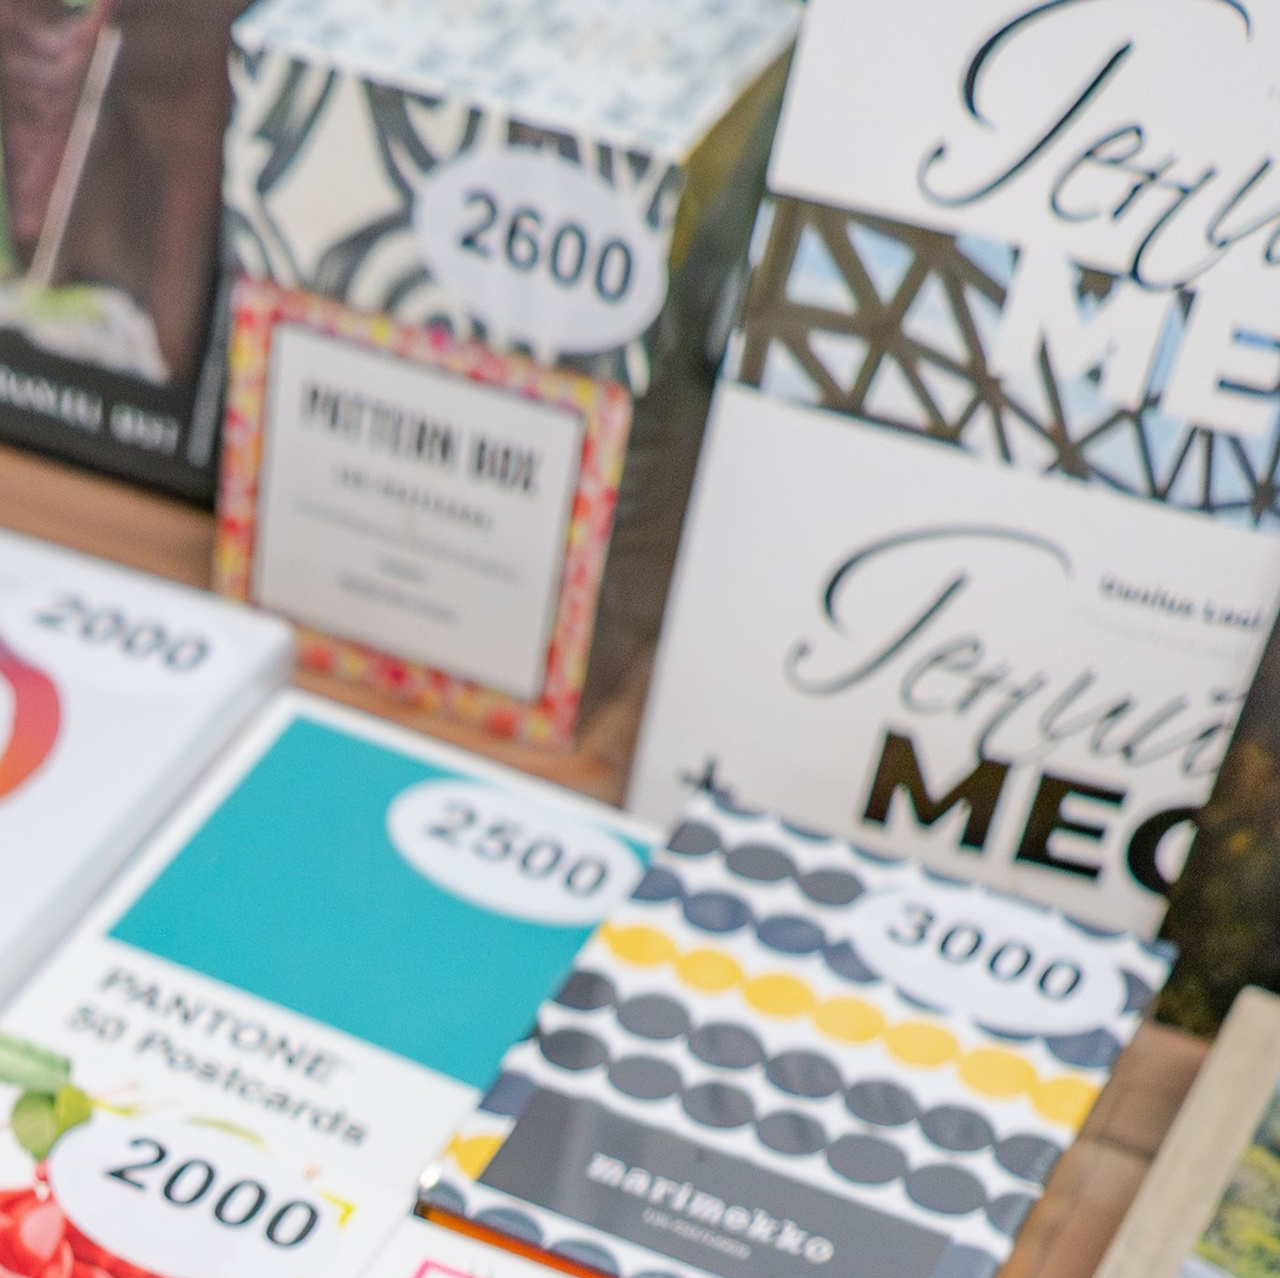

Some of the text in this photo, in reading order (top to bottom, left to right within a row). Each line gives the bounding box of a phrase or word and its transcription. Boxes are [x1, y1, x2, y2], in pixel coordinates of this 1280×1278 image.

[457, 188, 634, 304] 2600
[35, 591, 211, 674] 2000
[426, 799, 608, 899] 2500
[889, 902, 1084, 1003] 3000
[68, 1004, 368, 1146] 50 Postcards
[107, 1137, 320, 1249] 2000
[586, 1152, 834, 1265] marimekko
